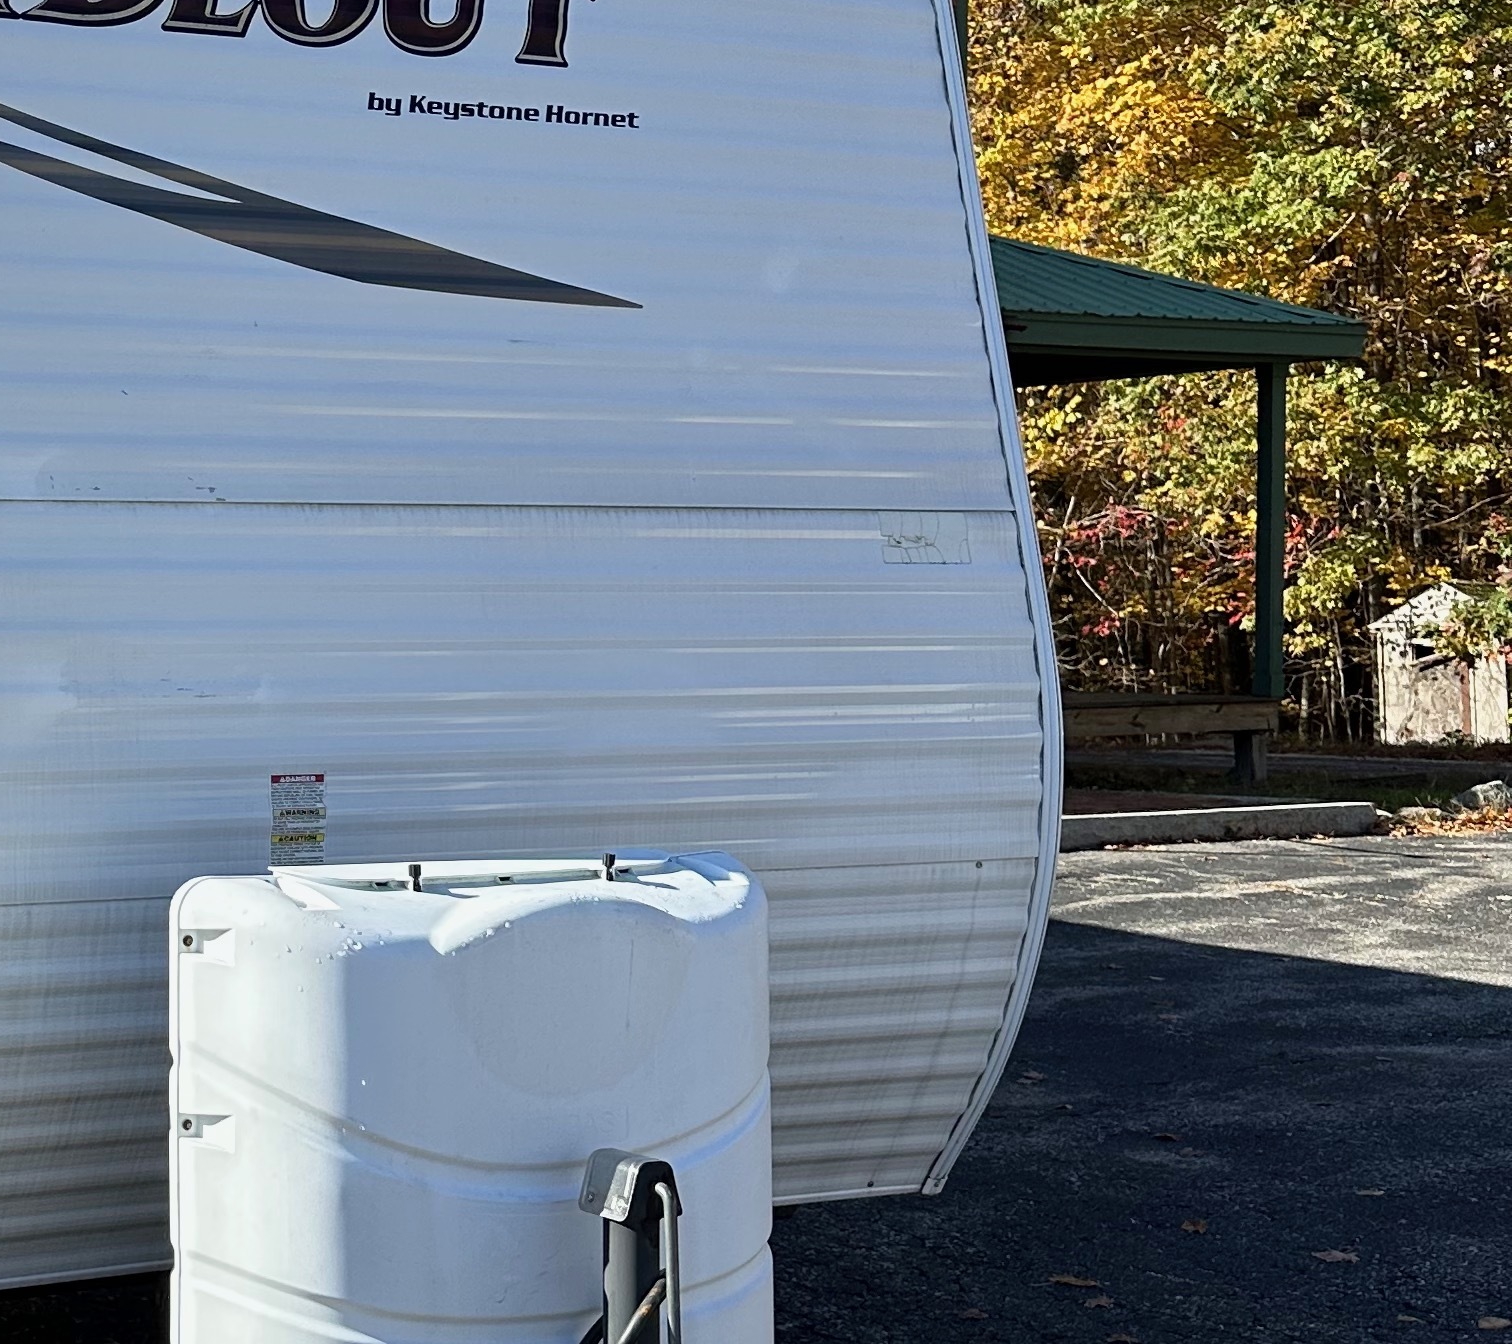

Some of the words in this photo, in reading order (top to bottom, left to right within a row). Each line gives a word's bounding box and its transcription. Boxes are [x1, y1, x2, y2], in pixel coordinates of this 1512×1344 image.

[367, 91, 402, 117] by
[408, 94, 540, 123] Keystone
[545, 104, 640, 129] Hornet
